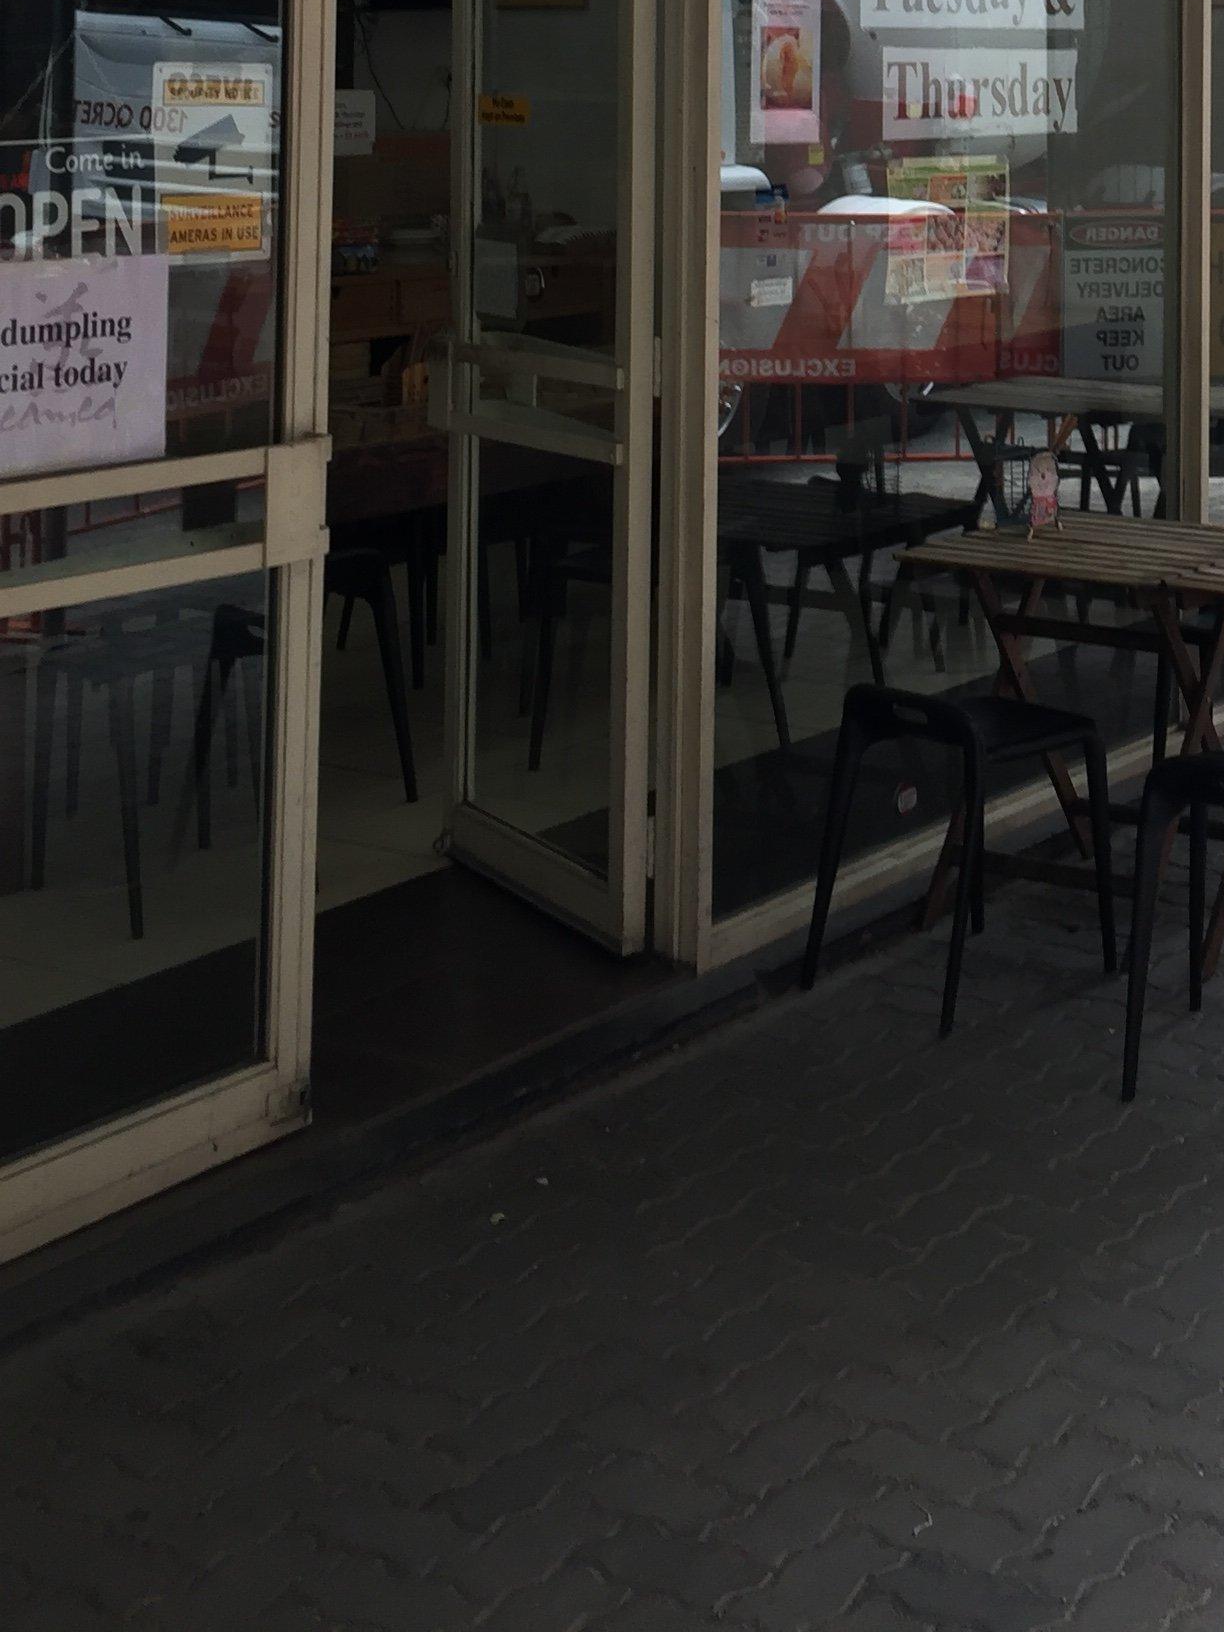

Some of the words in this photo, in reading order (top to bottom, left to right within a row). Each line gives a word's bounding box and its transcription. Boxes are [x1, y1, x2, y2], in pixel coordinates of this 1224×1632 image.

[887, 62, 1074, 133] Thursday
[45, 147, 114, 174] Come
[121, 143, 146, 169] in
[170, 229, 218, 244] AMERAS
[221, 228, 234, 241] IN
[237, 226, 259, 241] USE
[0, 311, 132, 348] dumpling
[54, 357, 128, 389] today
